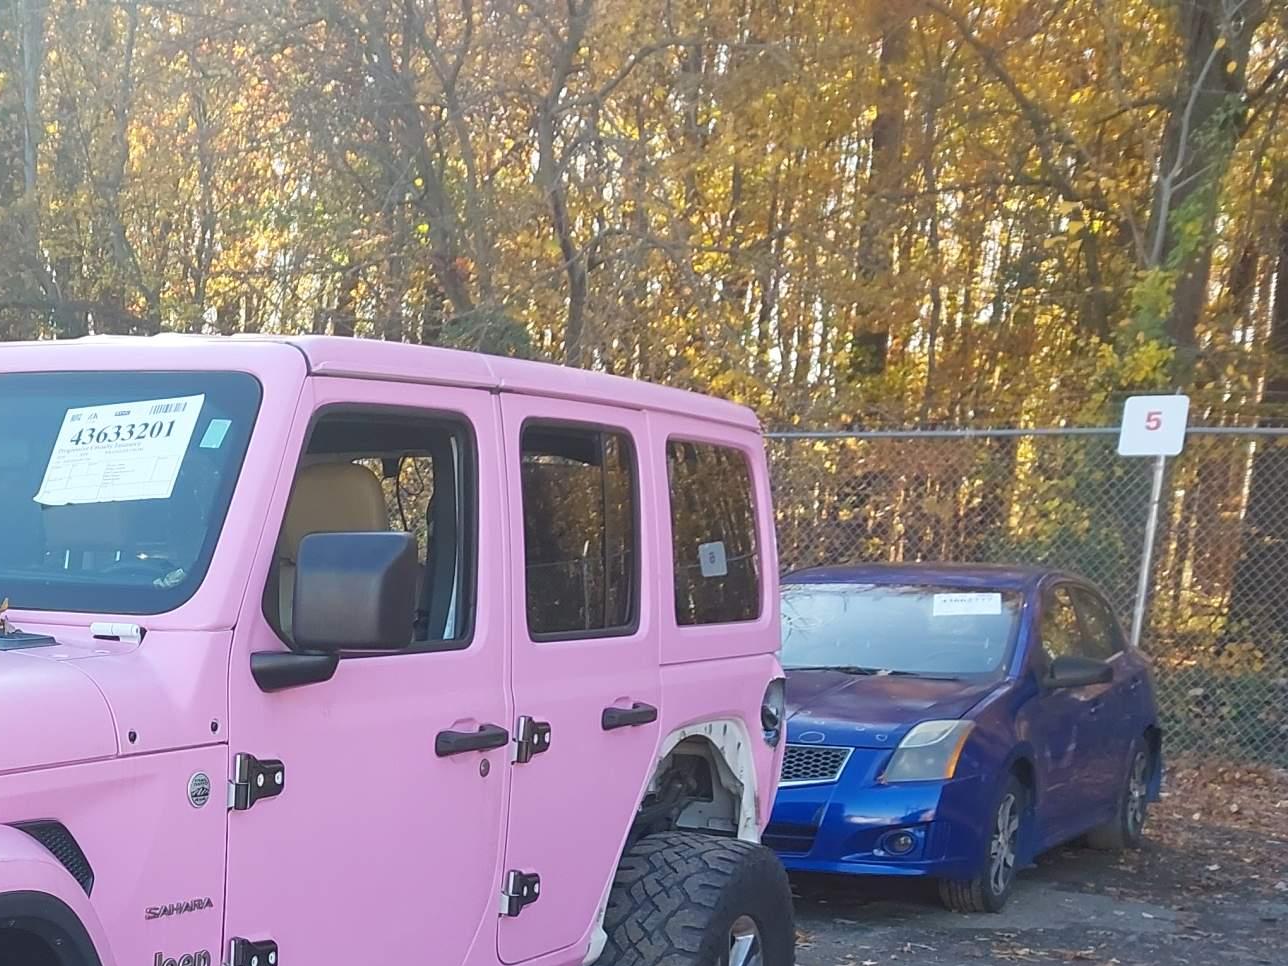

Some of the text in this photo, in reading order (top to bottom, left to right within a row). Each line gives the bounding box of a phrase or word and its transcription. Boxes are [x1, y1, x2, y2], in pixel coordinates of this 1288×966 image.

[1145, 411, 1162, 430] 5
[70, 420, 175, 445] 43633201
[145, 897, 213, 920] SAHARA
